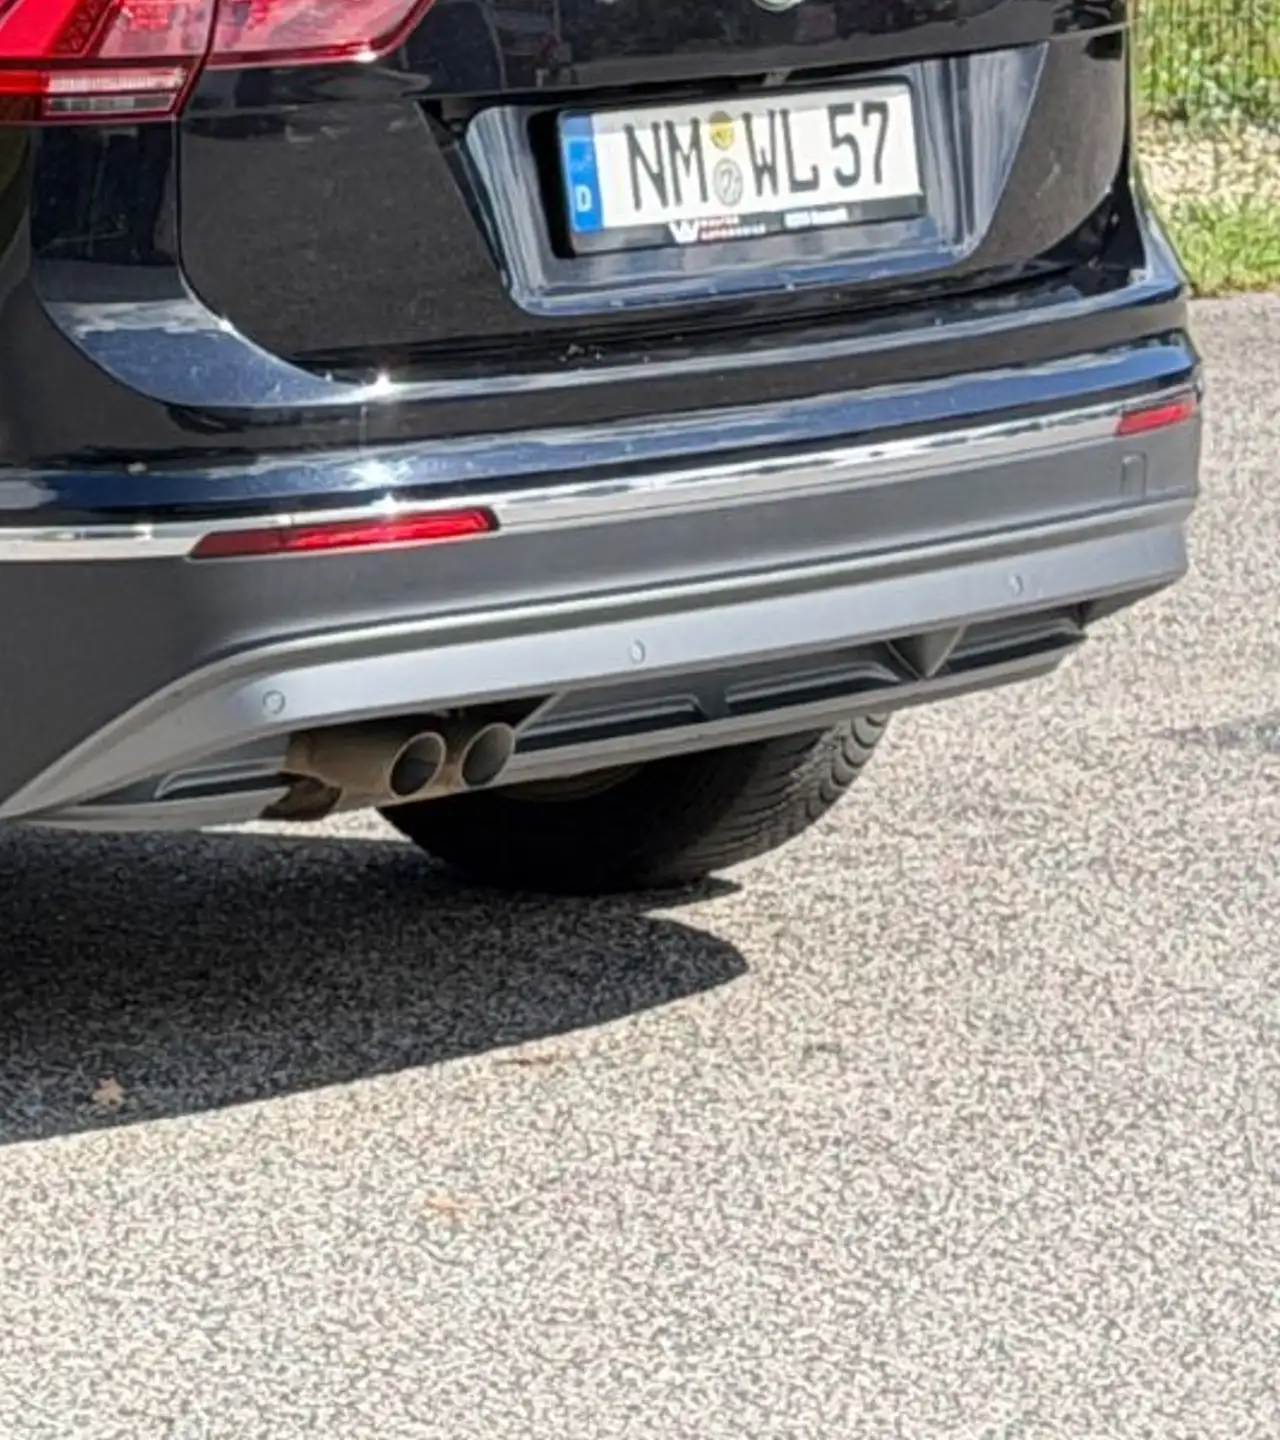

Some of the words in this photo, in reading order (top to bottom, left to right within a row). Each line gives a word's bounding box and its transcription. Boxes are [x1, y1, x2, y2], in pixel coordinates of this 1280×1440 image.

[624, 116, 709, 211] NM
[741, 107, 820, 198] WL
[827, 101, 889, 188] 57
[576, 184, 591, 210] D
